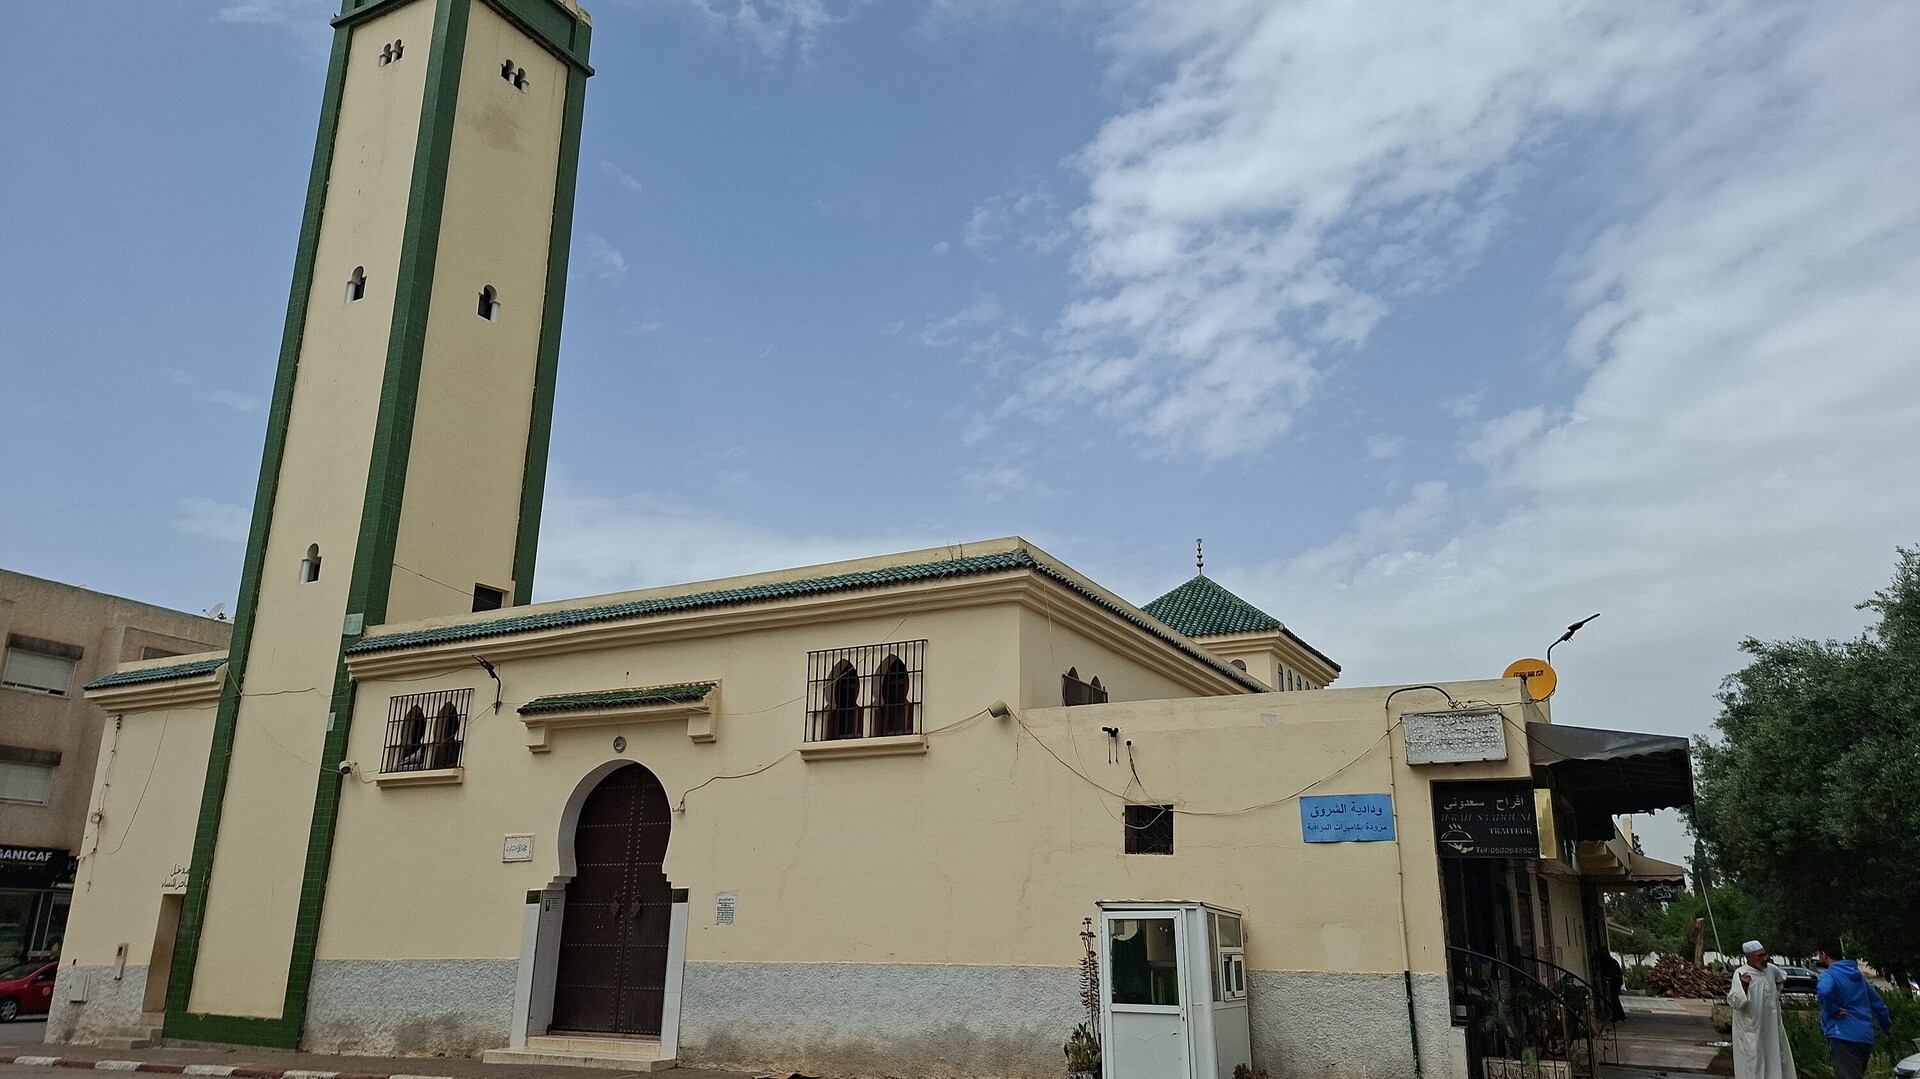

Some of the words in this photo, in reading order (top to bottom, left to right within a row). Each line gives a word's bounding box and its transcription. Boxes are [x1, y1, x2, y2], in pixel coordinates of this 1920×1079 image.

[1310, 803, 1347, 818] الشروق
[1351, 801, 1383, 816] ودادية
[1307, 822, 1332, 833] المراقبة
[1333, 823, 1364, 833] بكاميرات
[1365, 822, 1388, 832] مزودة
[1488, 827, 1532, 835] TRAITEUR
